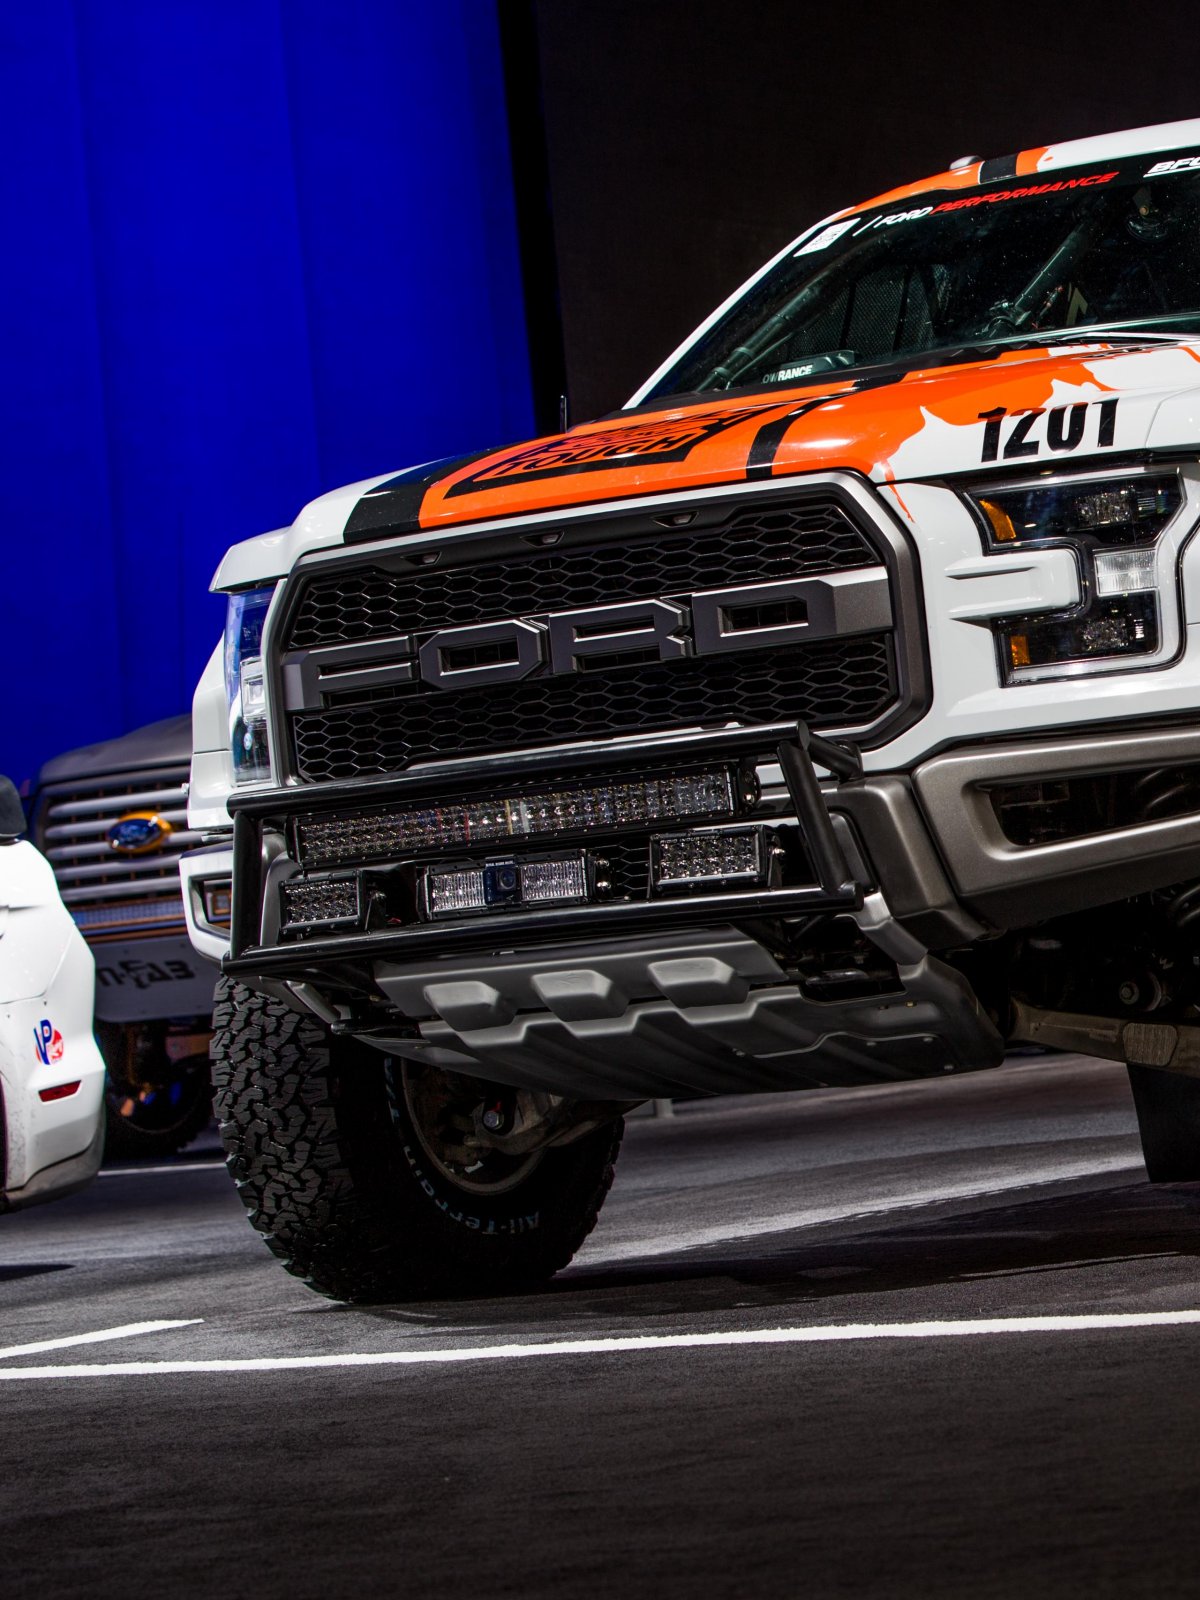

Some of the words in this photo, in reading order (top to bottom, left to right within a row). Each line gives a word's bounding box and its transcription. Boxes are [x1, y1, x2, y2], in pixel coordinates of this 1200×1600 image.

[873, 206, 933, 228] FORD
[928, 171, 1120, 215] PERFORMANCE
[761, 364, 813, 384] OWRANCE
[494, 432, 697, 476] TOUGH
[977, 397, 1120, 463] 1201
[299, 577, 838, 712] FORD
[33, 1018, 53, 1066] VP
